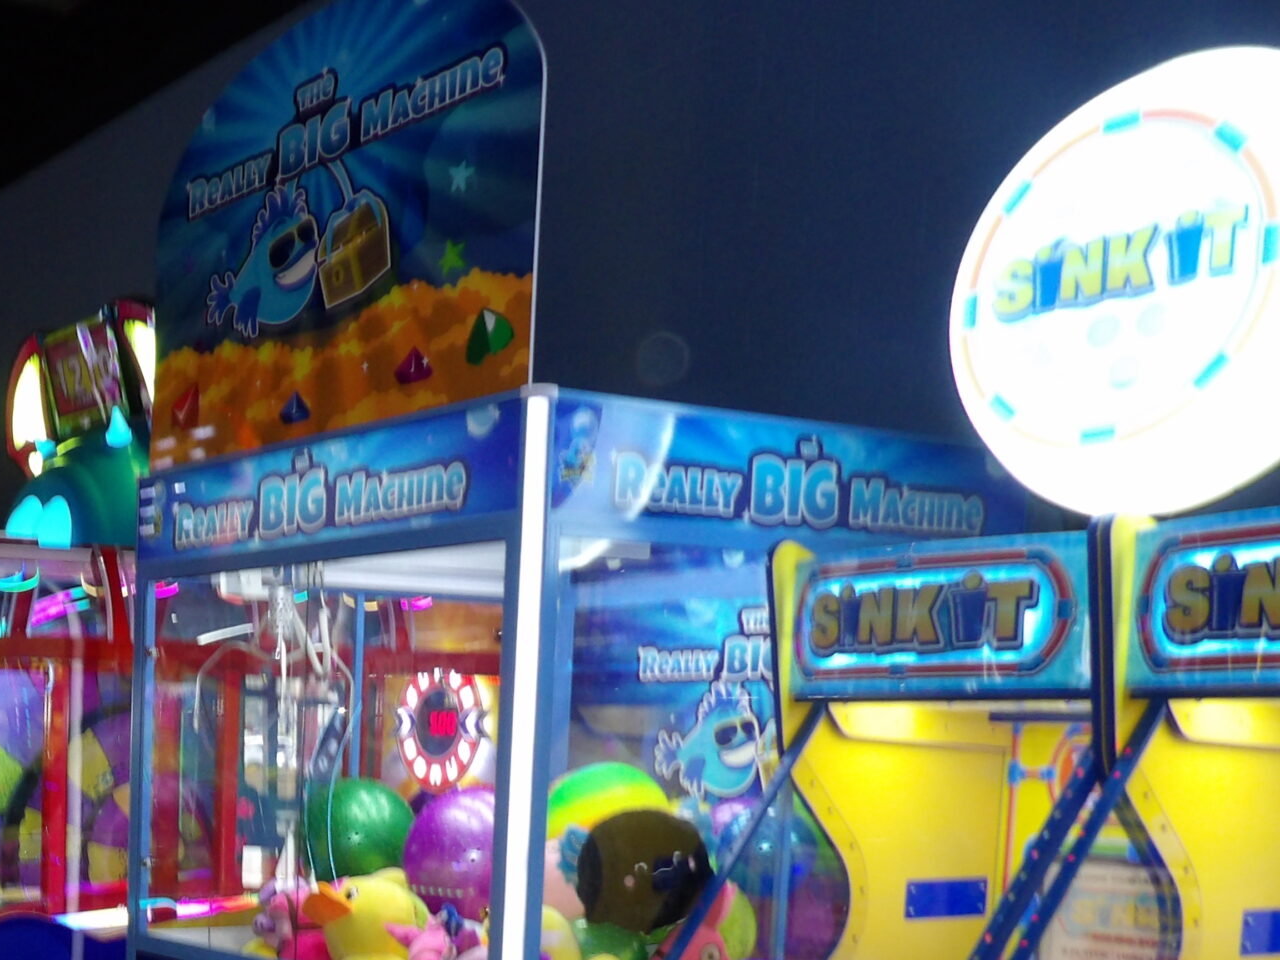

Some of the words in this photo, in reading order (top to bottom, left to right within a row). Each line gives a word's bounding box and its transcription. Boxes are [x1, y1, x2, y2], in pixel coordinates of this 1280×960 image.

[276, 99, 351, 179] BIG
[259, 466, 327, 539] BIG
[750, 452, 840, 529] BIG
[1163, 550, 1280, 644] SIN
